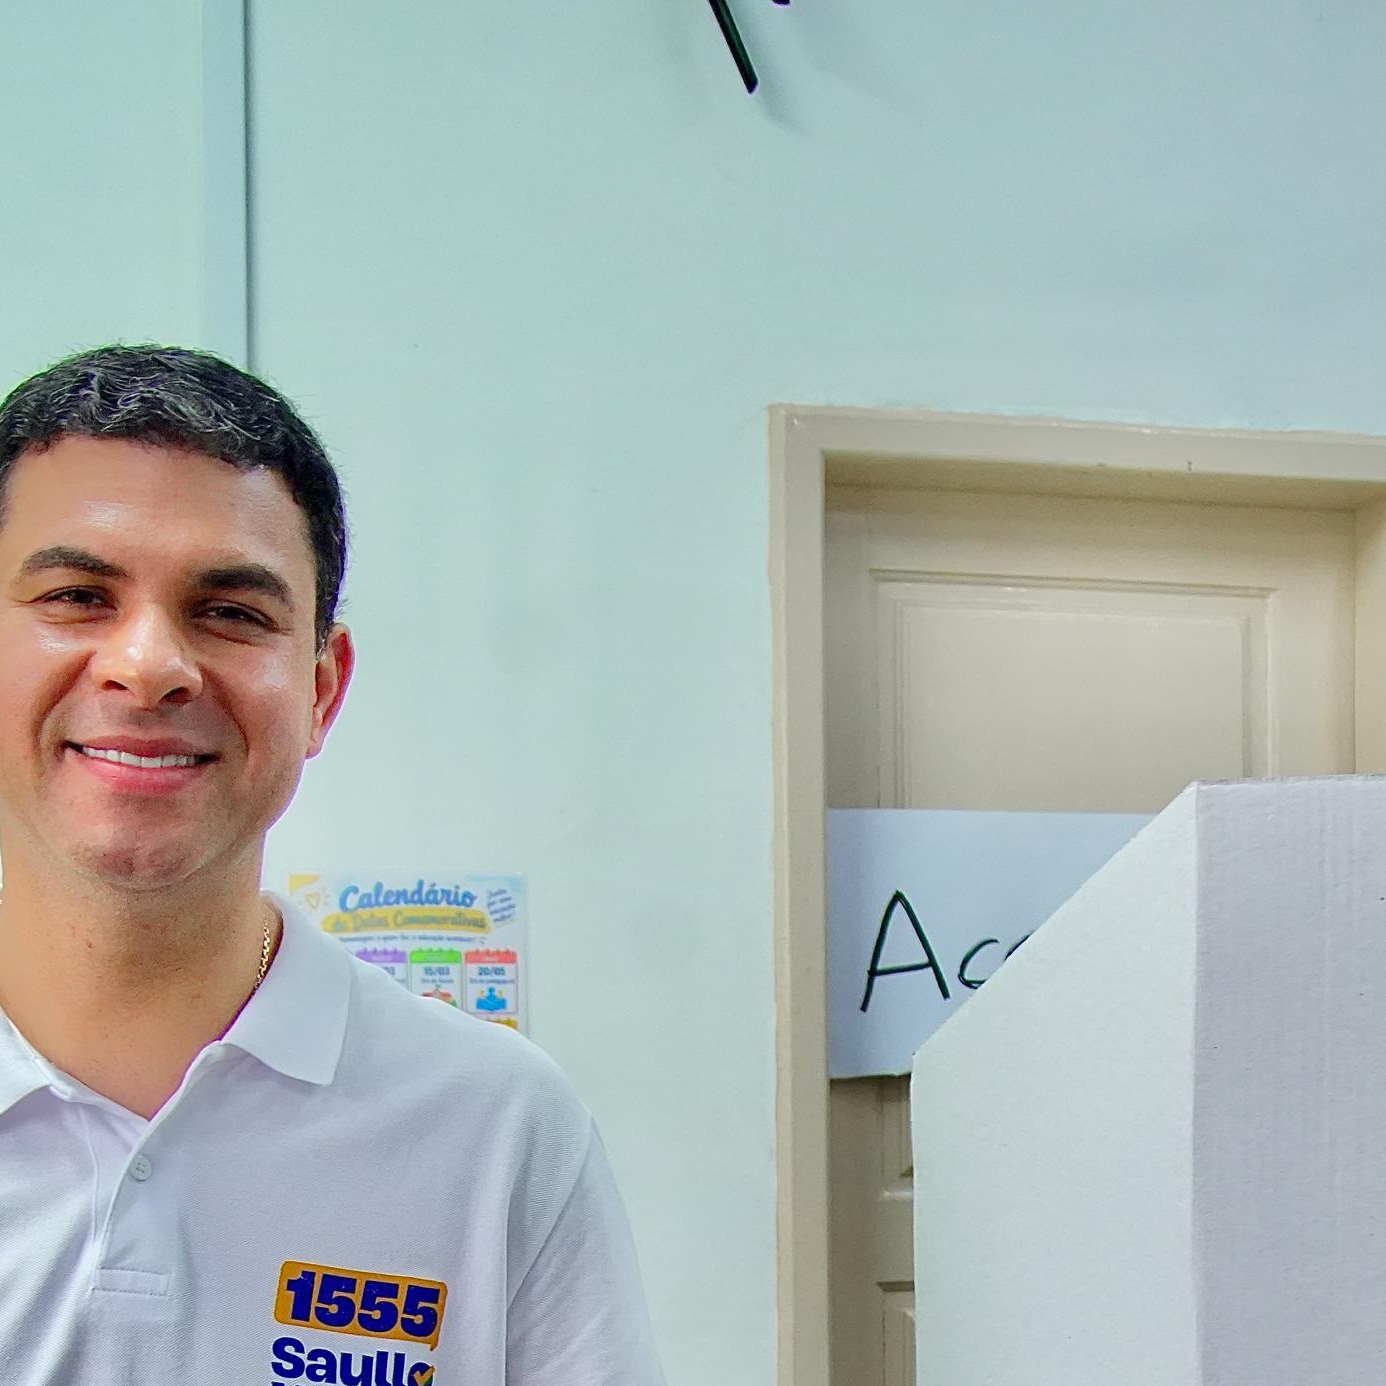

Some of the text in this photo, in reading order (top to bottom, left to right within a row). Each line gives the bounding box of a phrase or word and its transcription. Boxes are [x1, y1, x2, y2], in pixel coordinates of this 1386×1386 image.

[339, 879, 477, 912] Calendário
[394, 911, 486, 928] Comemorativas
[287, 1270, 440, 1337] 1555
